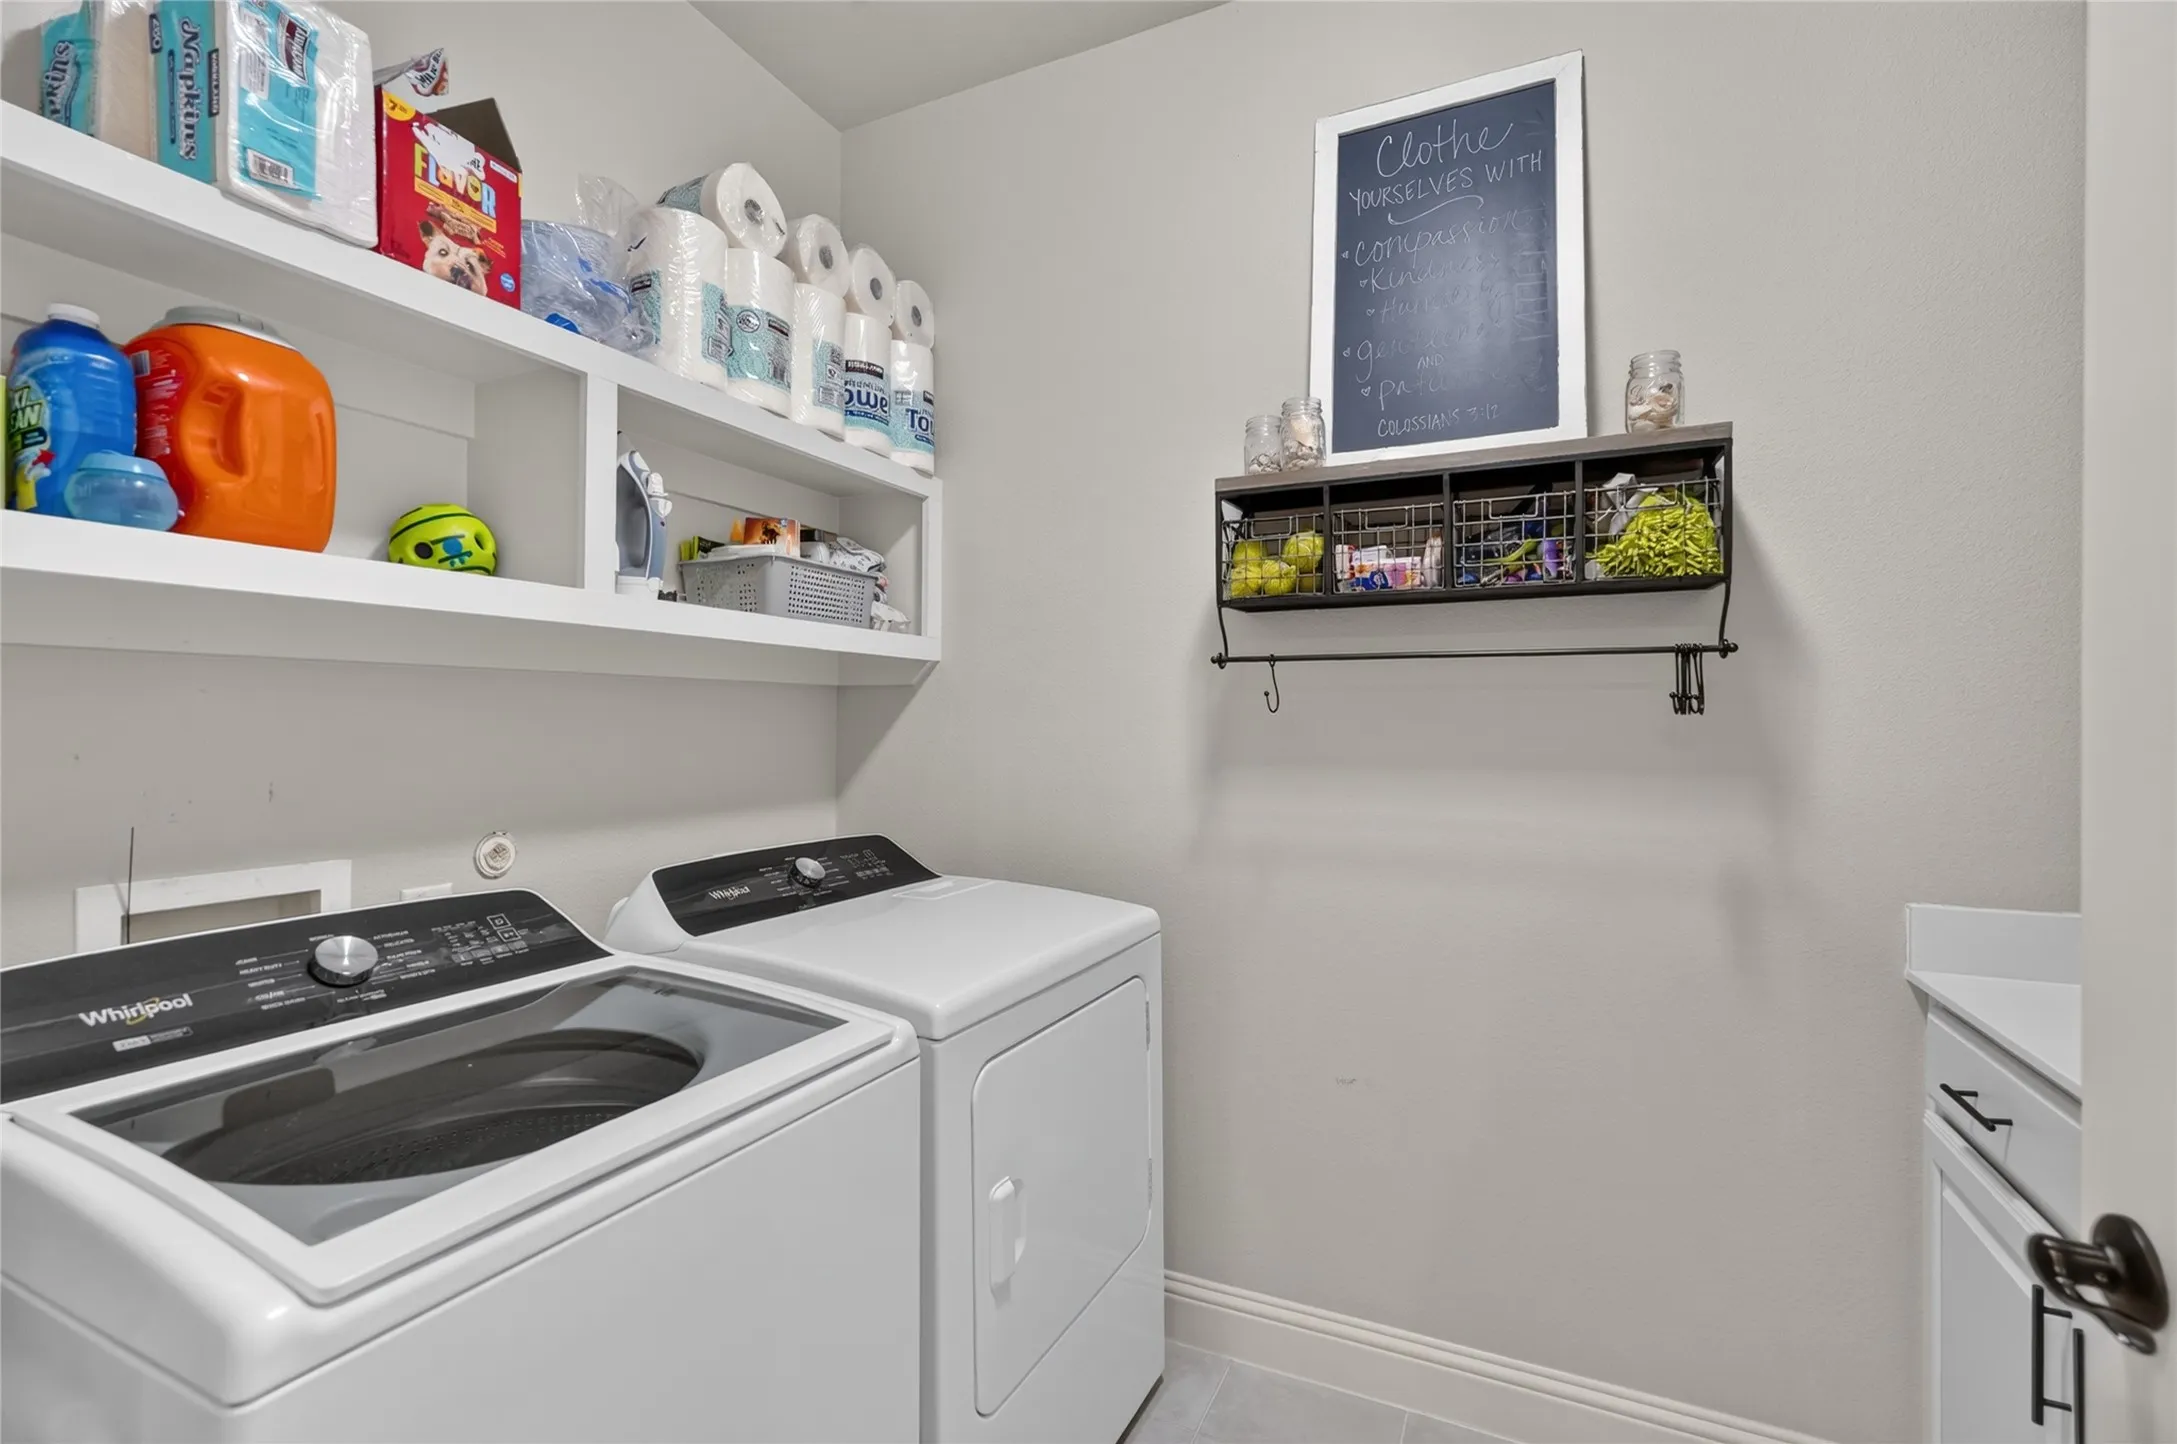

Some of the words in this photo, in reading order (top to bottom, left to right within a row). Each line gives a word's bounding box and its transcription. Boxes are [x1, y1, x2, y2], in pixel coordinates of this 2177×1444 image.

[46, 41, 69, 120] pkins
[179, 18, 201, 159] Napkins
[1377, 118, 1514, 178] Clothe
[1349, 166, 1474, 217] YOURSELVES
[1485, 149, 1543, 184] WITH
[1416, 353, 1444, 370] AND
[844, 387, 889, 416] owe
[905, 408, 935, 436] To
[1377, 407, 1461, 437] COLOSSIANS
[1466, 402, 1500, 424] 3:12
[78, 993, 194, 1028] Whirlpool
